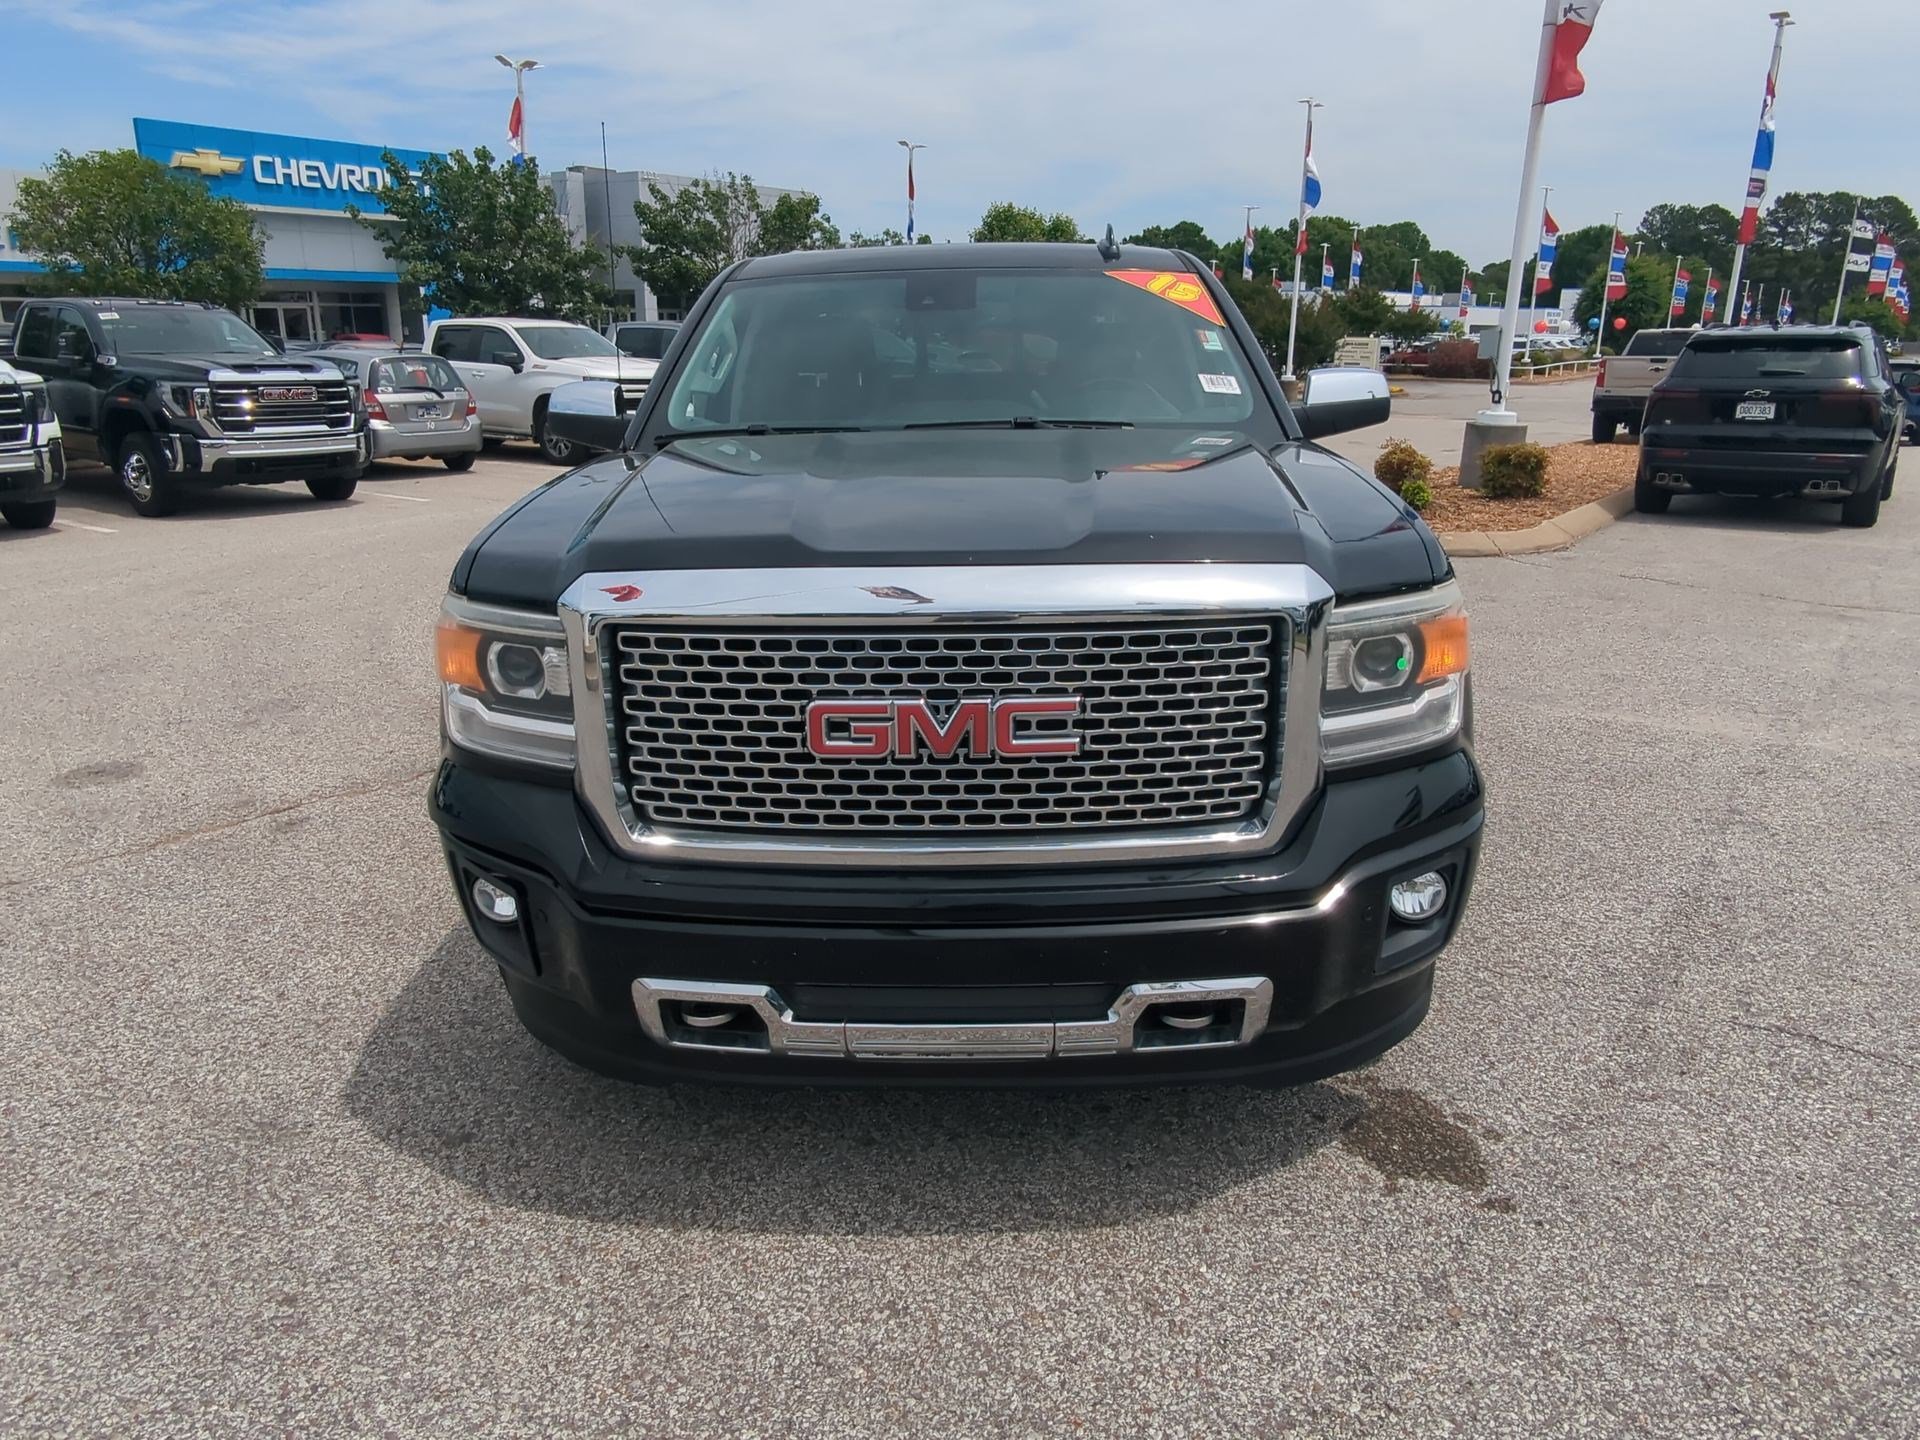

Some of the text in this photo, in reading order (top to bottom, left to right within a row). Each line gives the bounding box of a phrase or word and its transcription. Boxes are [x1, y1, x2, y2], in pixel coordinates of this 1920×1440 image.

[252, 155, 430, 197] CHEVRO
[264, 388, 313, 400] GMC
[806, 696, 1083, 760] GMC
